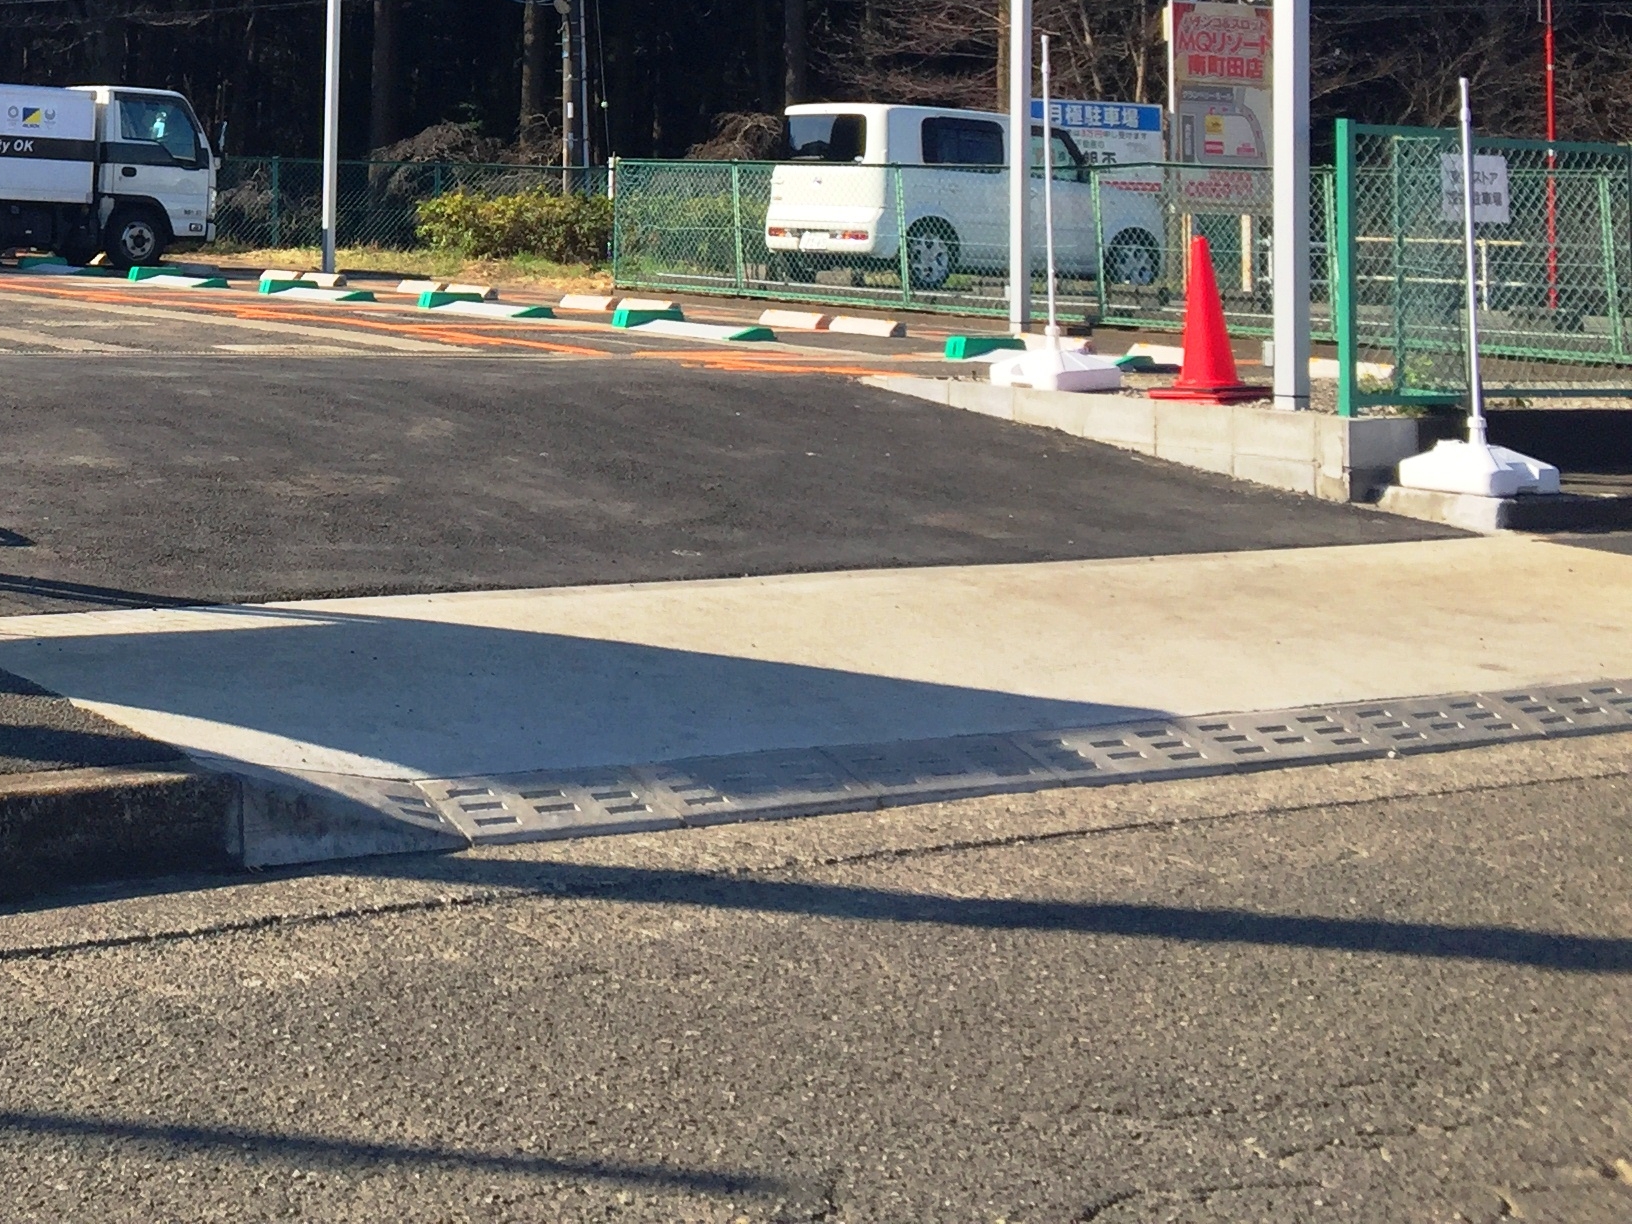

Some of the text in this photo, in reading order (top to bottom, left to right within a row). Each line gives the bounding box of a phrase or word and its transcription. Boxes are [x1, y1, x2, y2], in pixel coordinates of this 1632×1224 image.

[1188, 54, 1264, 79] 南町田店
[1050, 103, 1140, 128] 月極駐車場
[13, 139, 35, 153] OK
